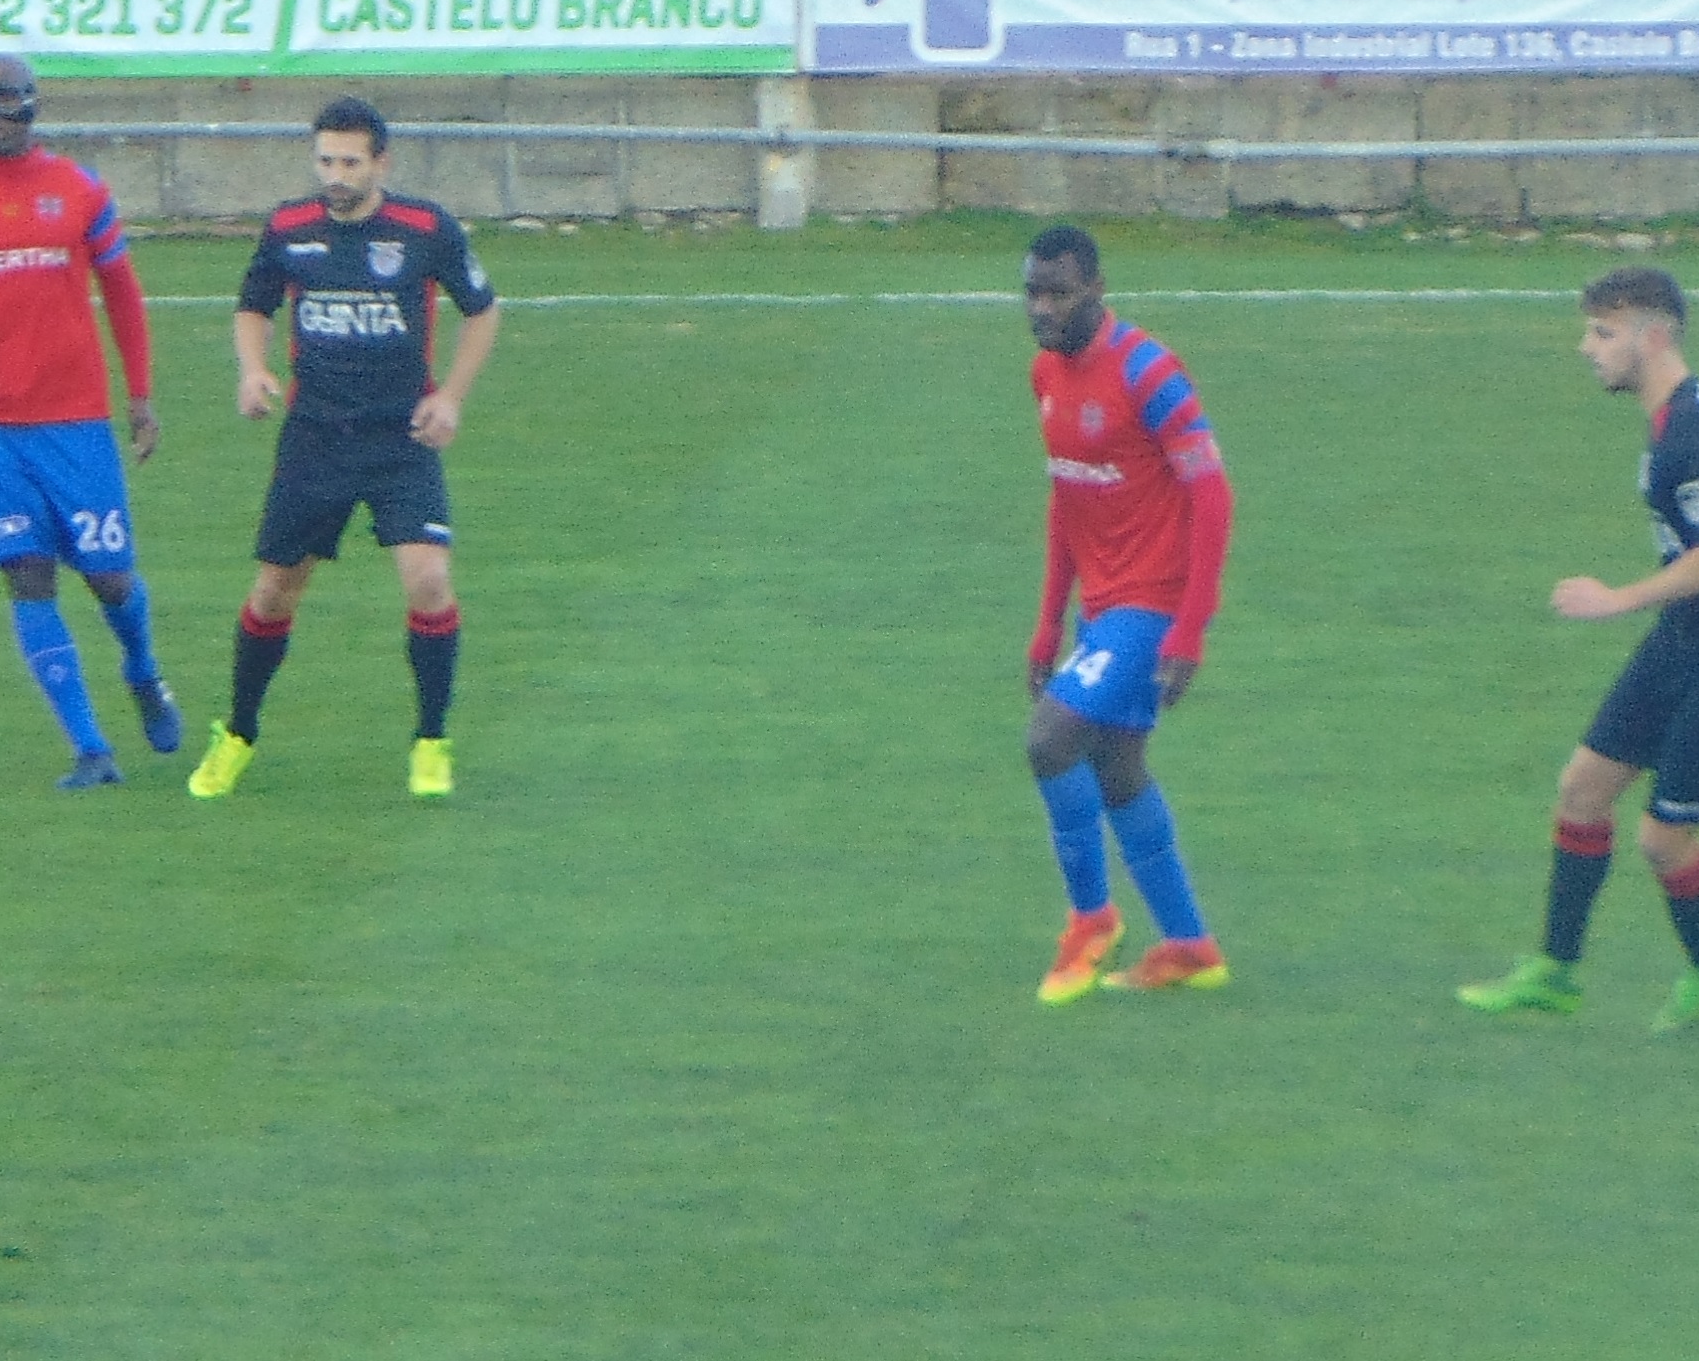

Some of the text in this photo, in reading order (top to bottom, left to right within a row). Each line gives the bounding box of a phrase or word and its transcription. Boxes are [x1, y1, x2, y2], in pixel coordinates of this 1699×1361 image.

[1123, 31, 1178, 59] Rua
[1230, 31, 1298, 59] Zona
[1303, 30, 1432, 59] Industrial
[1436, 31, 1496, 58] Lote
[70, 508, 126, 554] 26
